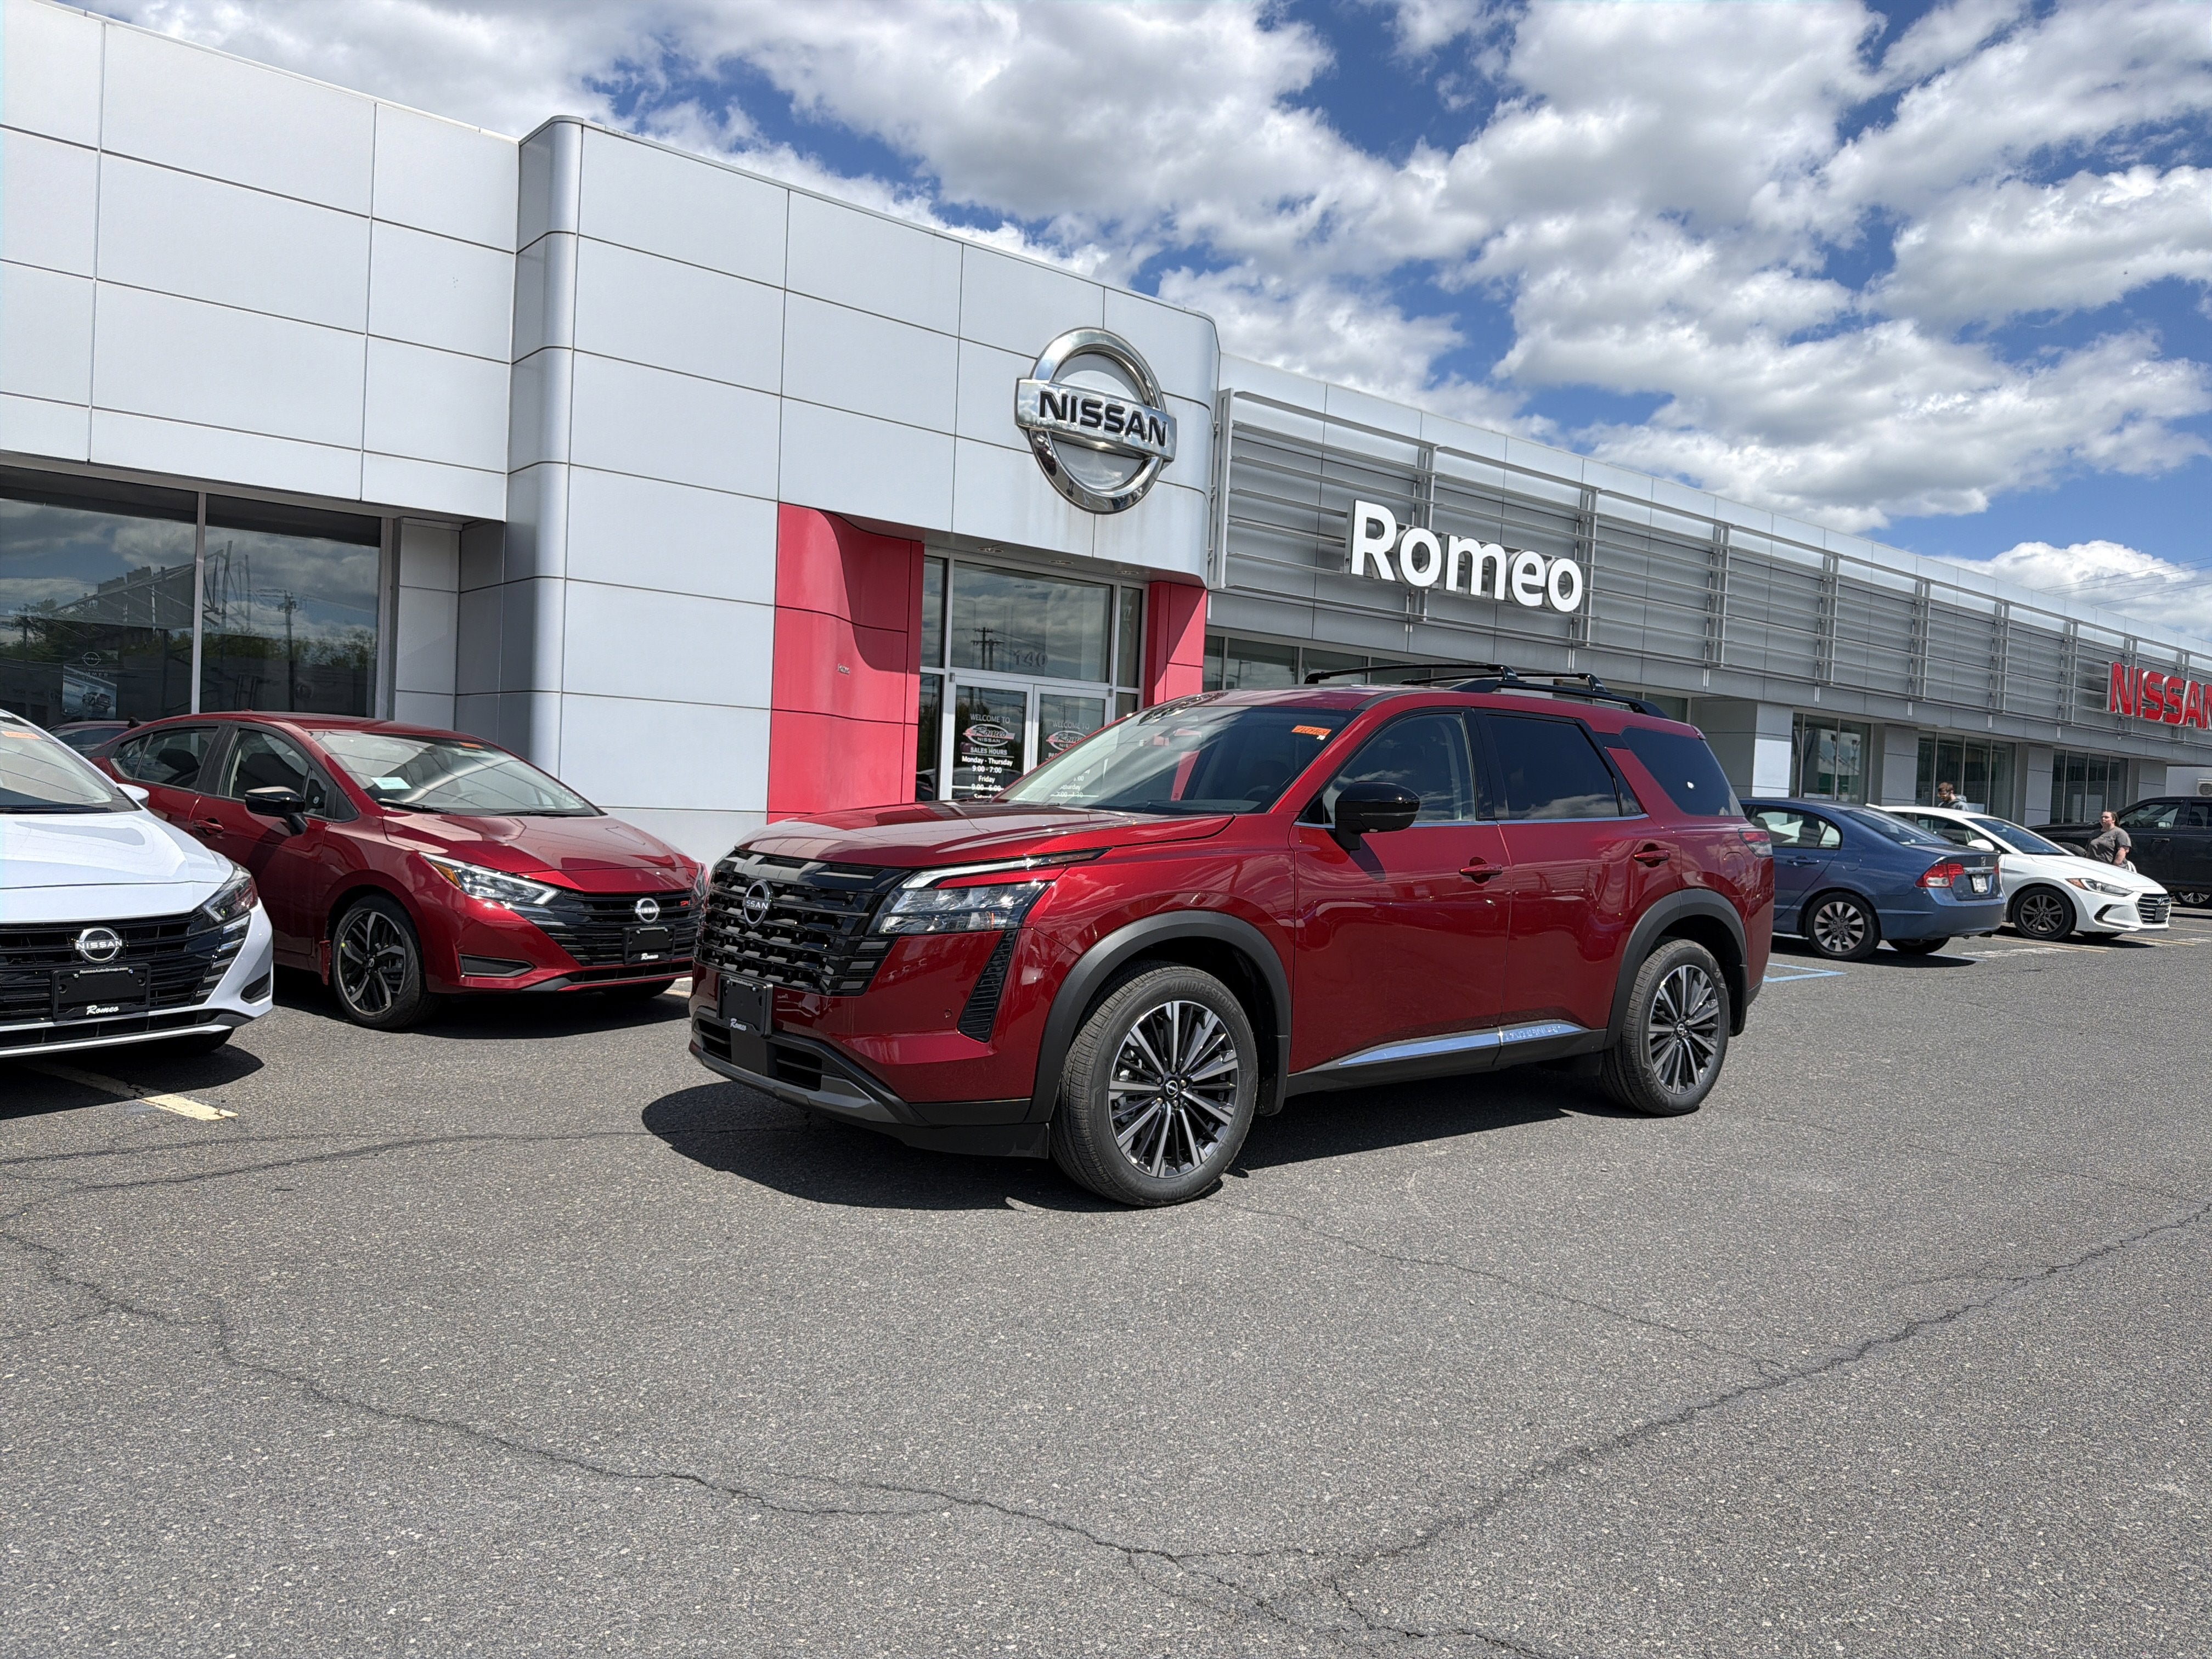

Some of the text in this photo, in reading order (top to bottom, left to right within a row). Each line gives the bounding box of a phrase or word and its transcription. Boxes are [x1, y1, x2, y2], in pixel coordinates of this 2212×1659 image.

[1040, 390, 1167, 448] NISSAN
[1350, 499, 1583, 613] Romeo
[1013, 650, 1048, 668] 140
[970, 713, 1001, 723] WELCOME
[1053, 721, 1080, 729] WELCOME
[973, 725, 1007, 737] Romeo
[962, 756, 984, 765] Monday
[988, 758, 1013, 767] Thursday
[978, 775, 996, 783] Friday
[746, 900, 769, 910] SSAN
[76, 940, 122, 950] NISSAN
[1170, 980, 1238, 1016] BRIDGESTONE
[86, 1005, 120, 1015] Romeo
